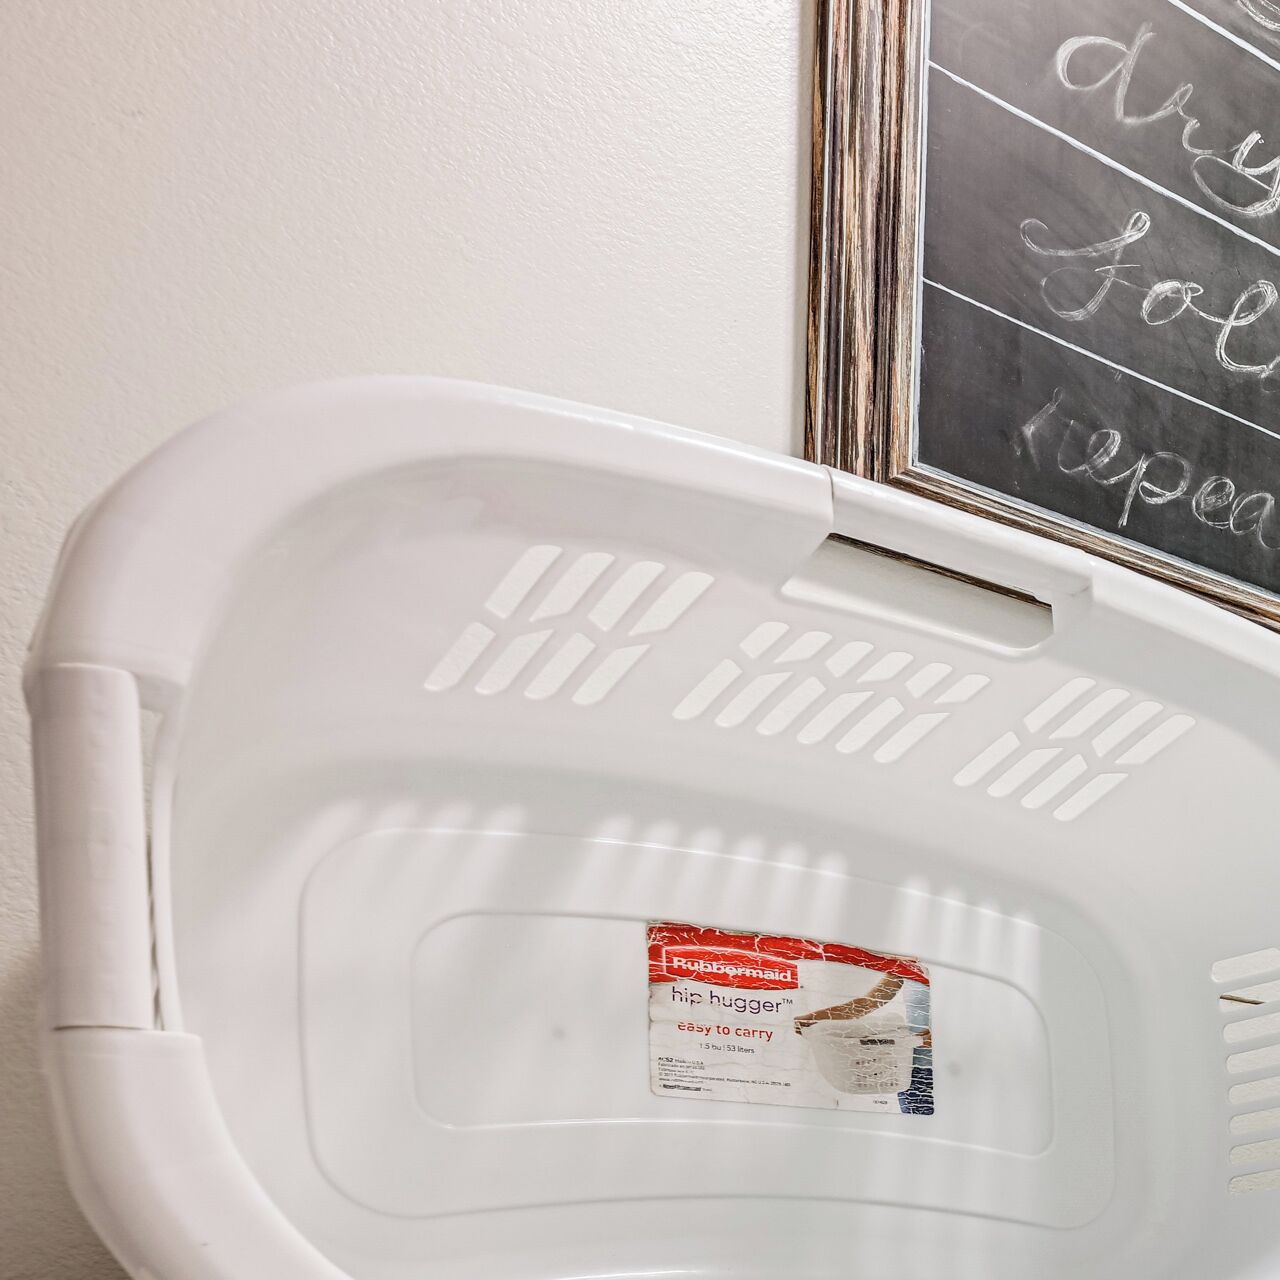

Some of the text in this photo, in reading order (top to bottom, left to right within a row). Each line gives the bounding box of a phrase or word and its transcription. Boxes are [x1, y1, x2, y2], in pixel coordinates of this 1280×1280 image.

[671, 956, 791, 982] Rubbermaid
[672, 986, 702, 1007] hip
[677, 1022, 773, 1042] easy to carry
